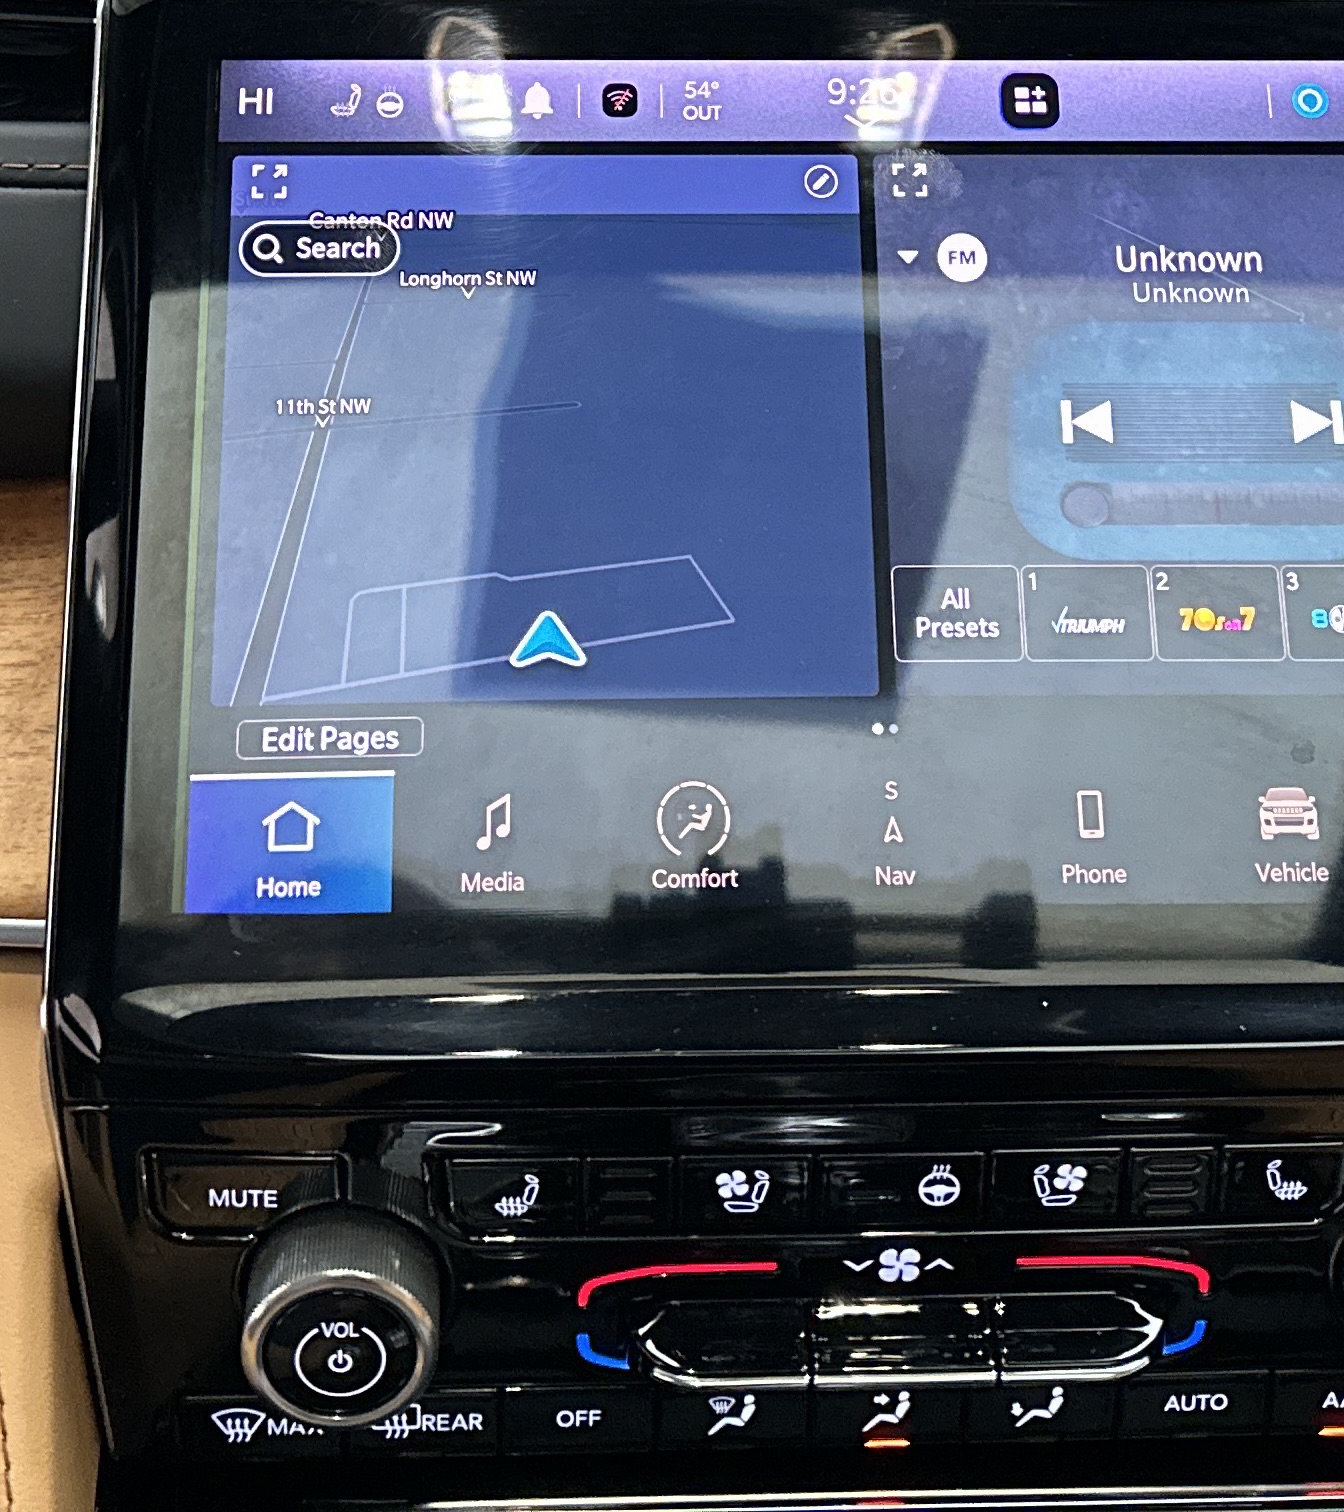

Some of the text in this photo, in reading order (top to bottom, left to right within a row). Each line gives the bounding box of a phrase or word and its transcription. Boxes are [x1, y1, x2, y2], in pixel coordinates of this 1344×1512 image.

[238, 88, 274, 115] HI
[682, 104, 721, 121] OUT
[308, 211, 454, 230] Canton Rd NW
[295, 236, 381, 260] Search
[948, 249, 976, 266] FM
[1114, 245, 1263, 274] Unknown
[399, 271, 537, 289] Longhorn St NW
[1132, 283, 1250, 304] Unknown
[276, 399, 372, 414] 11th St NW
[1028, 572, 1037, 591] 1
[1156, 572, 1169, 591] 2
[1286, 572, 1299, 591] 3
[941, 588, 970, 609] All
[916, 617, 1000, 639] Presets
[262, 726, 399, 756] Edit Pages
[460, 872, 525, 893] Media
[652, 868, 739, 890] Comfort
[875, 866, 916, 886] Nav
[1062, 864, 1127, 885] Phone
[1255, 863, 1329, 884] Vehicle
[256, 876, 321, 899] Home
[208, 1188, 279, 1209] MUTE
[321, 1322, 360, 1338] VOL
[1164, 1392, 1229, 1413] AUTO
[422, 1412, 484, 1433] REAR
[556, 1410, 602, 1428] OFF
